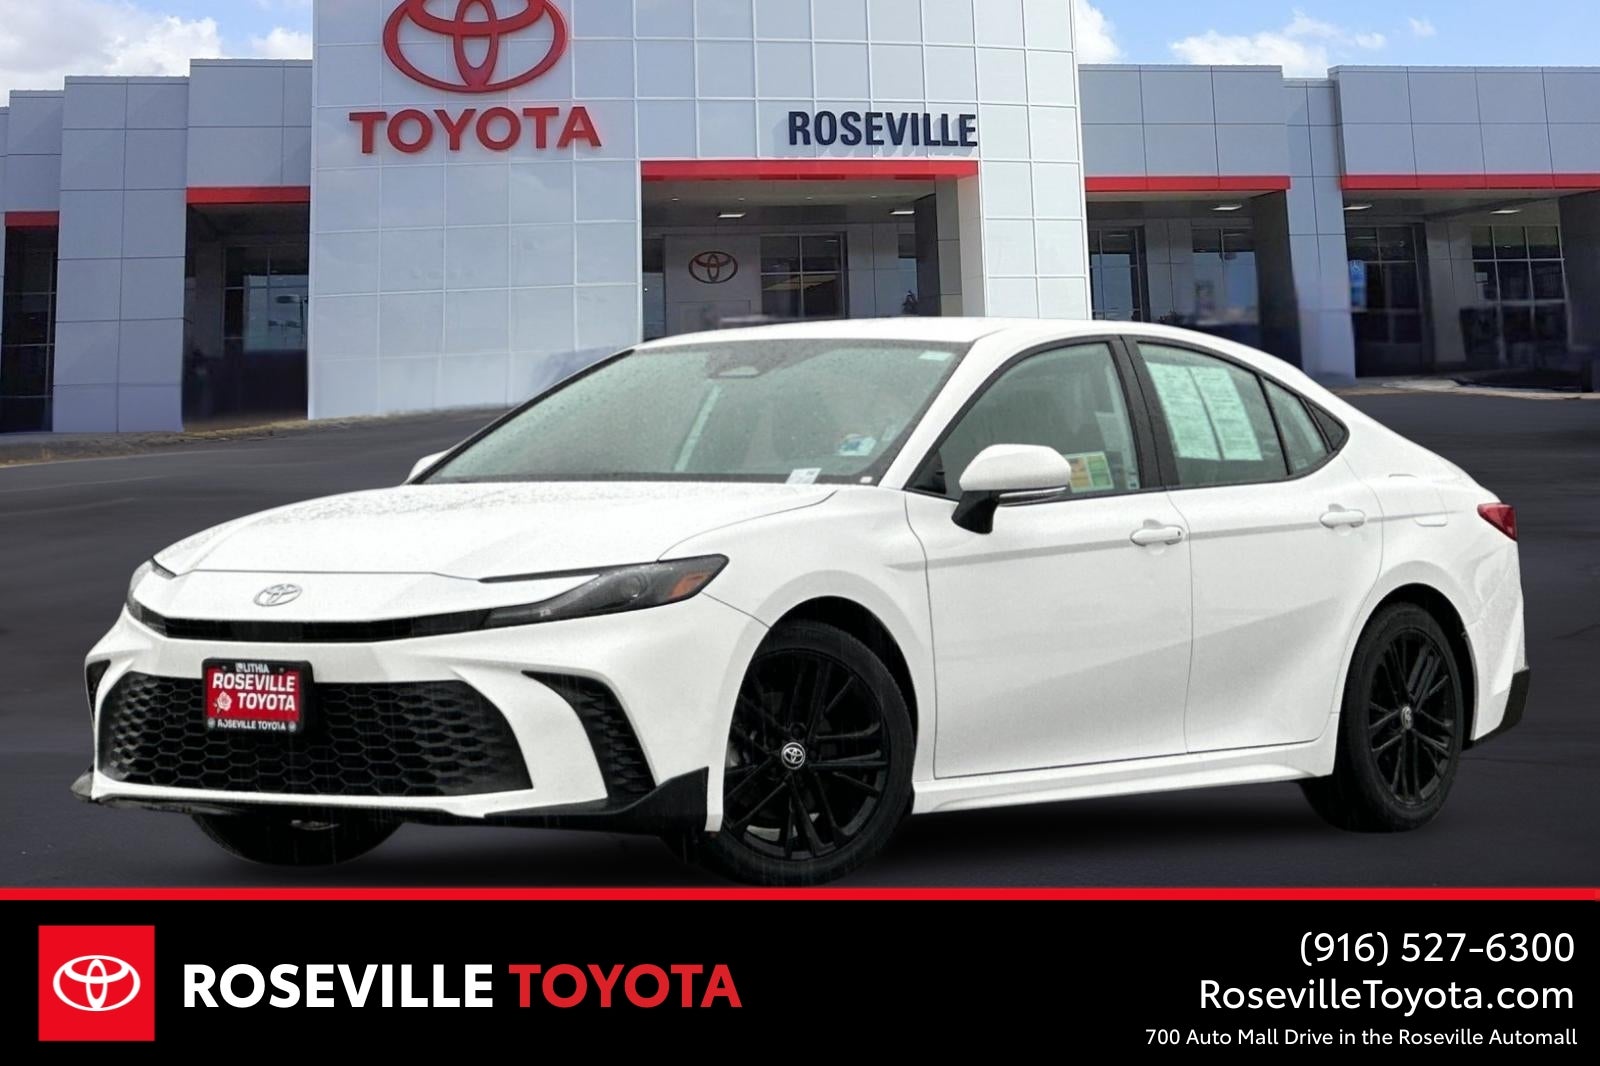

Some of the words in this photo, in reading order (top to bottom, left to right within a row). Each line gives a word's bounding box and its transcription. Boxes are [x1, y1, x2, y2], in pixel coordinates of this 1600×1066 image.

[349, 106, 602, 154] TOYOTA
[788, 110, 978, 147] ROSEVILLE
[243, 663, 270, 673] LITHIA
[212, 672, 296, 692] ROSEVILLE
[237, 692, 296, 711] TOYOTA
[217, 719, 257, 730] ROSEVILLE
[258, 720, 287, 731] TOYOTA
